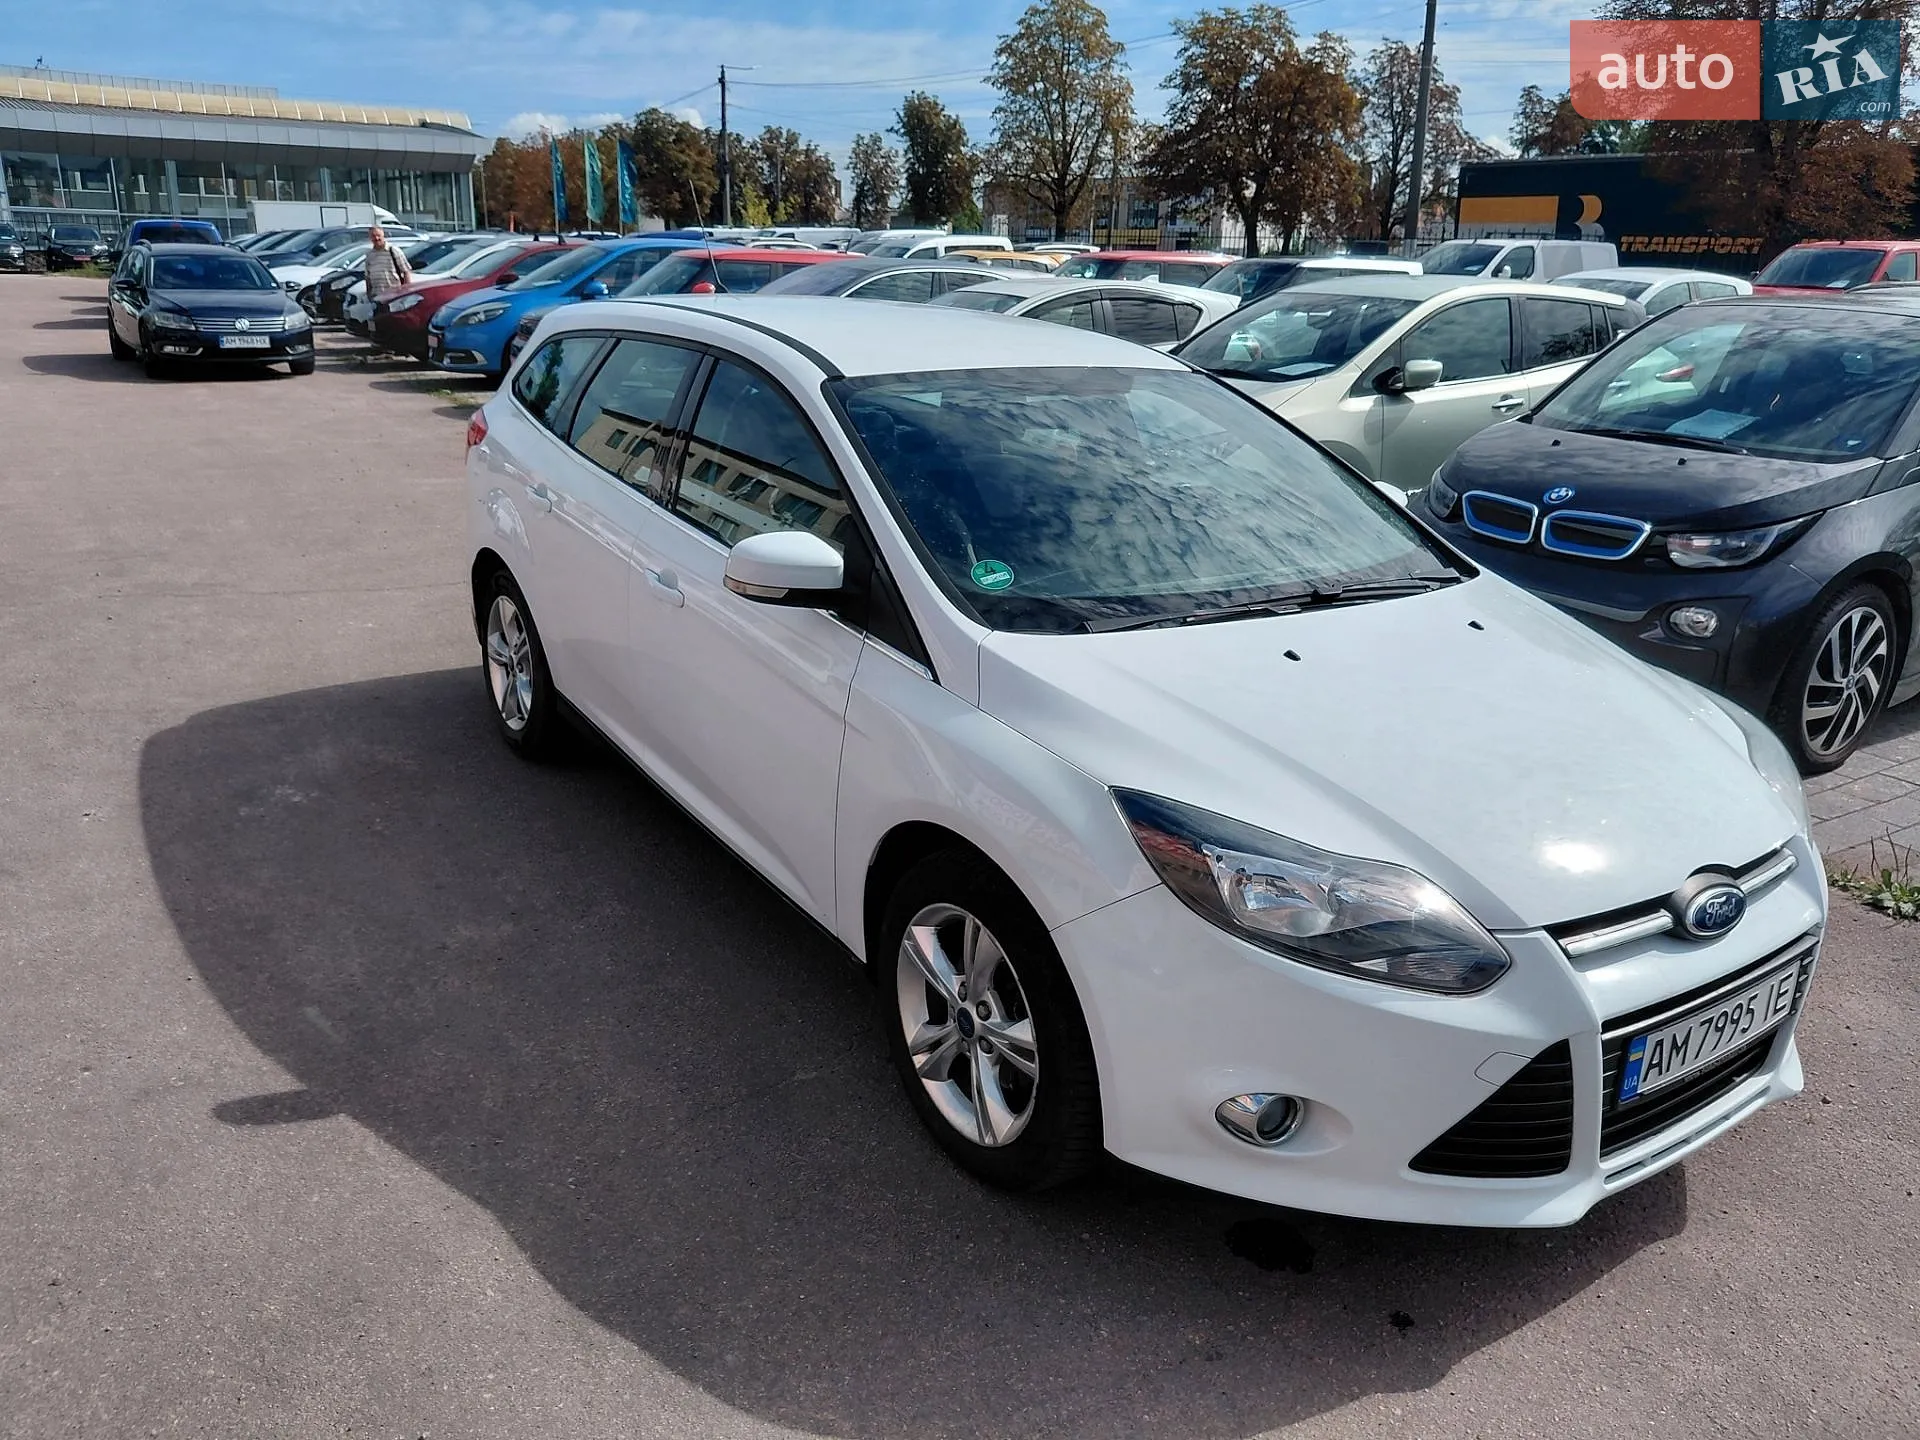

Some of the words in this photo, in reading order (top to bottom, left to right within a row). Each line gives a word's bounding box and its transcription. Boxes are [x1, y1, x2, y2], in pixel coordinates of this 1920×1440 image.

[1620, 235, 1764, 254] TRANSPORT
[1705, 895, 1736, 927] Ford
[1642, 1025, 1693, 1083] AM
[1694, 993, 1760, 1060] 7995
[1764, 971, 1794, 1023] IE
[1624, 1074, 1638, 1090] UA
